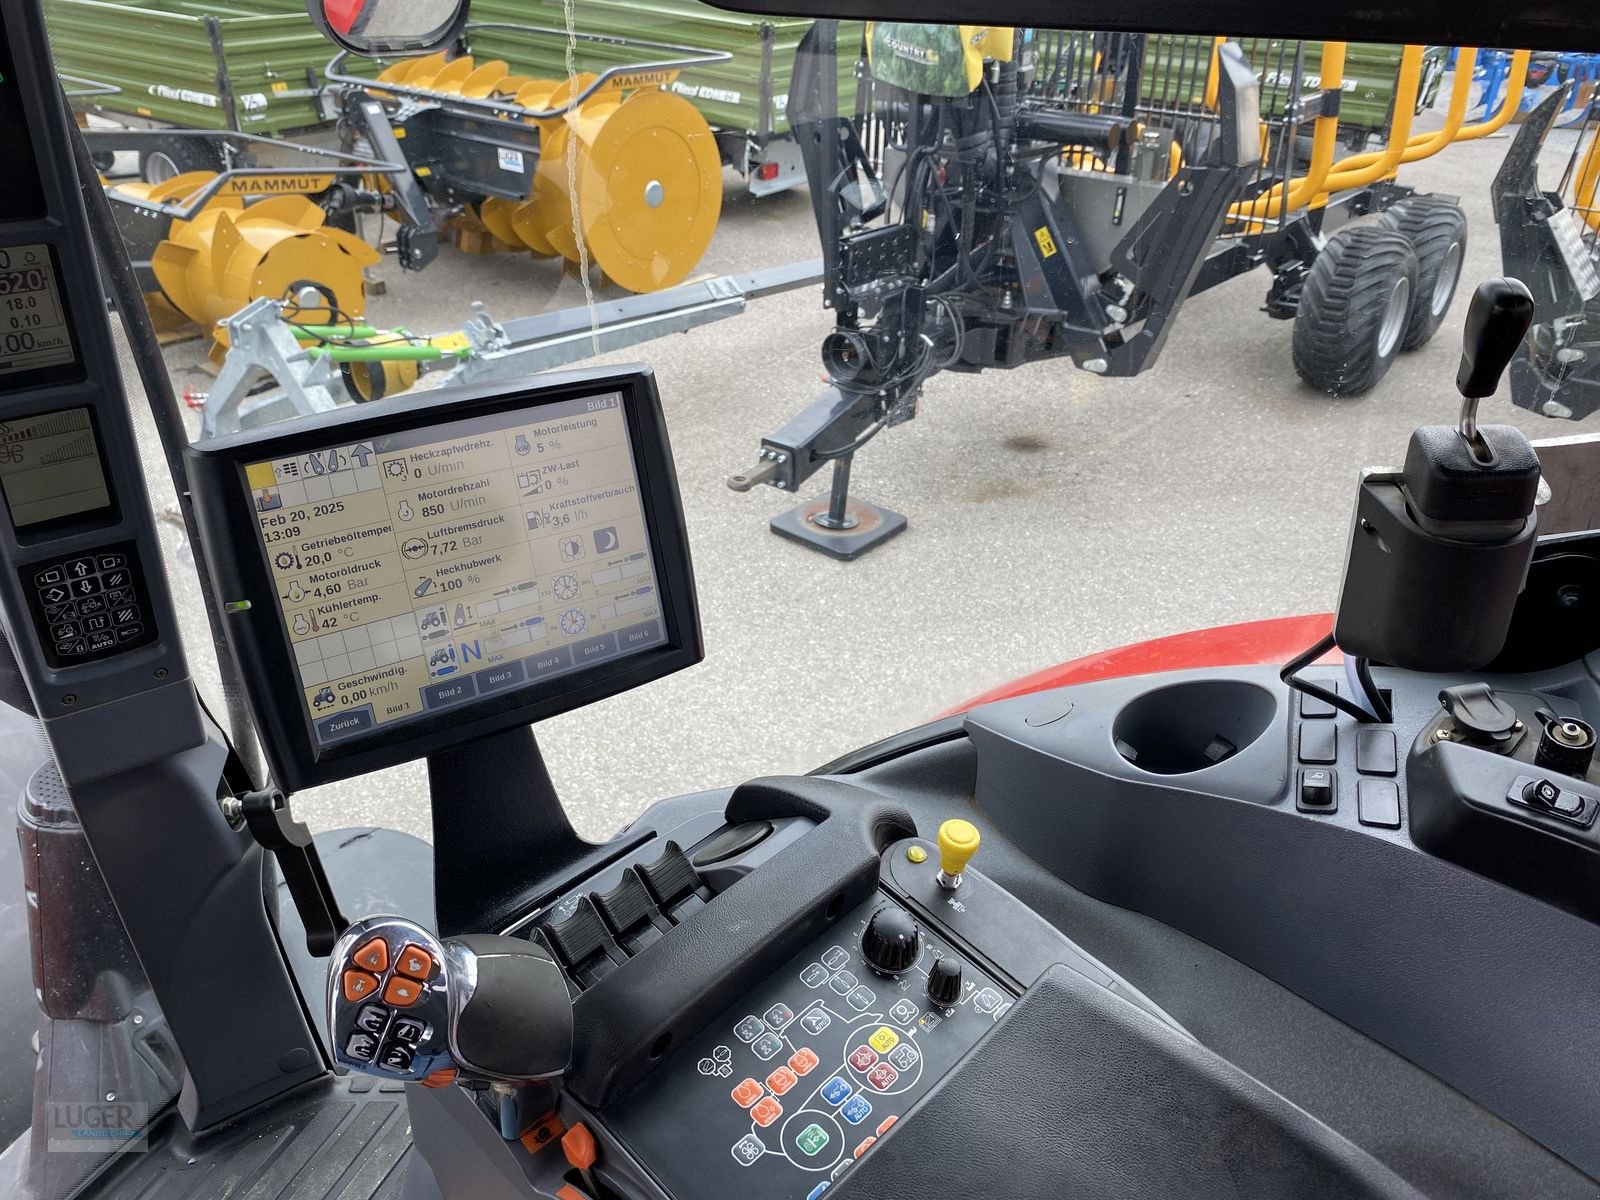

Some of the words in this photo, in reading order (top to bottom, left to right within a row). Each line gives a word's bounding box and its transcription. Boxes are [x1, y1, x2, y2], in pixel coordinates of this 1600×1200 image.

[612, 72, 672, 88] MAMMUT
[231, 178, 321, 193] MAMMUT
[6, 296, 37, 311] 18.0
[10, 314, 41, 329] 0.10
[36, 338, 63, 349] km/h
[587, 397, 607, 411] Bild
[533, 417, 597, 438] Motorleistung
[410, 440, 494, 462] Heckzapfwdrehz.
[537, 443, 545, 453] 5
[550, 440, 561, 450] %
[414, 468, 422, 479] 0
[428, 461, 465, 476] U/min
[418, 479, 490, 501] Motordrehzahl
[544, 480, 552, 490] 0
[557, 476, 569, 487] %
[549, 485, 635, 511] Kraftstoffverbrauch
[260, 515, 287, 528] Feb
[290, 510, 311, 524] 20,
[313, 501, 345, 517] 2025
[422, 504, 445, 517] 850
[450, 496, 487, 511] U/min
[427, 515, 505, 539] Luftbremsdruck
[552, 514, 570, 527] 3,6
[264, 526, 301, 543] 13:09
[431, 541, 458, 556] 7,72
[462, 536, 482, 548] Bar
[305, 552, 332, 567] 20,0
[338, 546, 354, 557] °C
[309, 559, 381, 584] Motoröldruck
[436, 554, 502, 577] Heckhubwerk
[313, 583, 342, 599] 4,60
[347, 578, 369, 590] Bar
[439, 578, 463, 593] 100
[468, 575, 480, 586] %
[317, 593, 382, 616] Kühlertemp.
[322, 617, 338, 629] 42
[343, 611, 360, 623] °C
[479, 618, 496, 628] MAX
[91, 639, 113, 649] AUTO
[628, 631, 643, 641] Bild
[460, 639, 482, 663] N
[584, 645, 599, 655] Bild
[537, 659, 553, 669] Bild
[338, 666, 408, 691] Geschwindig.
[489, 673, 505, 684] Bild
[341, 690, 367, 705] 0,00
[369, 681, 399, 697] km/h
[438, 688, 455, 700] Bild
[386, 704, 403, 715] Bild
[329, 717, 360, 733] Zurück
[815, 1020, 827, 1031] AUTO
[882, 1037, 895, 1049] AUTO
[881, 1073, 895, 1088] AUTO
[854, 1106, 868, 1121] AUTO
